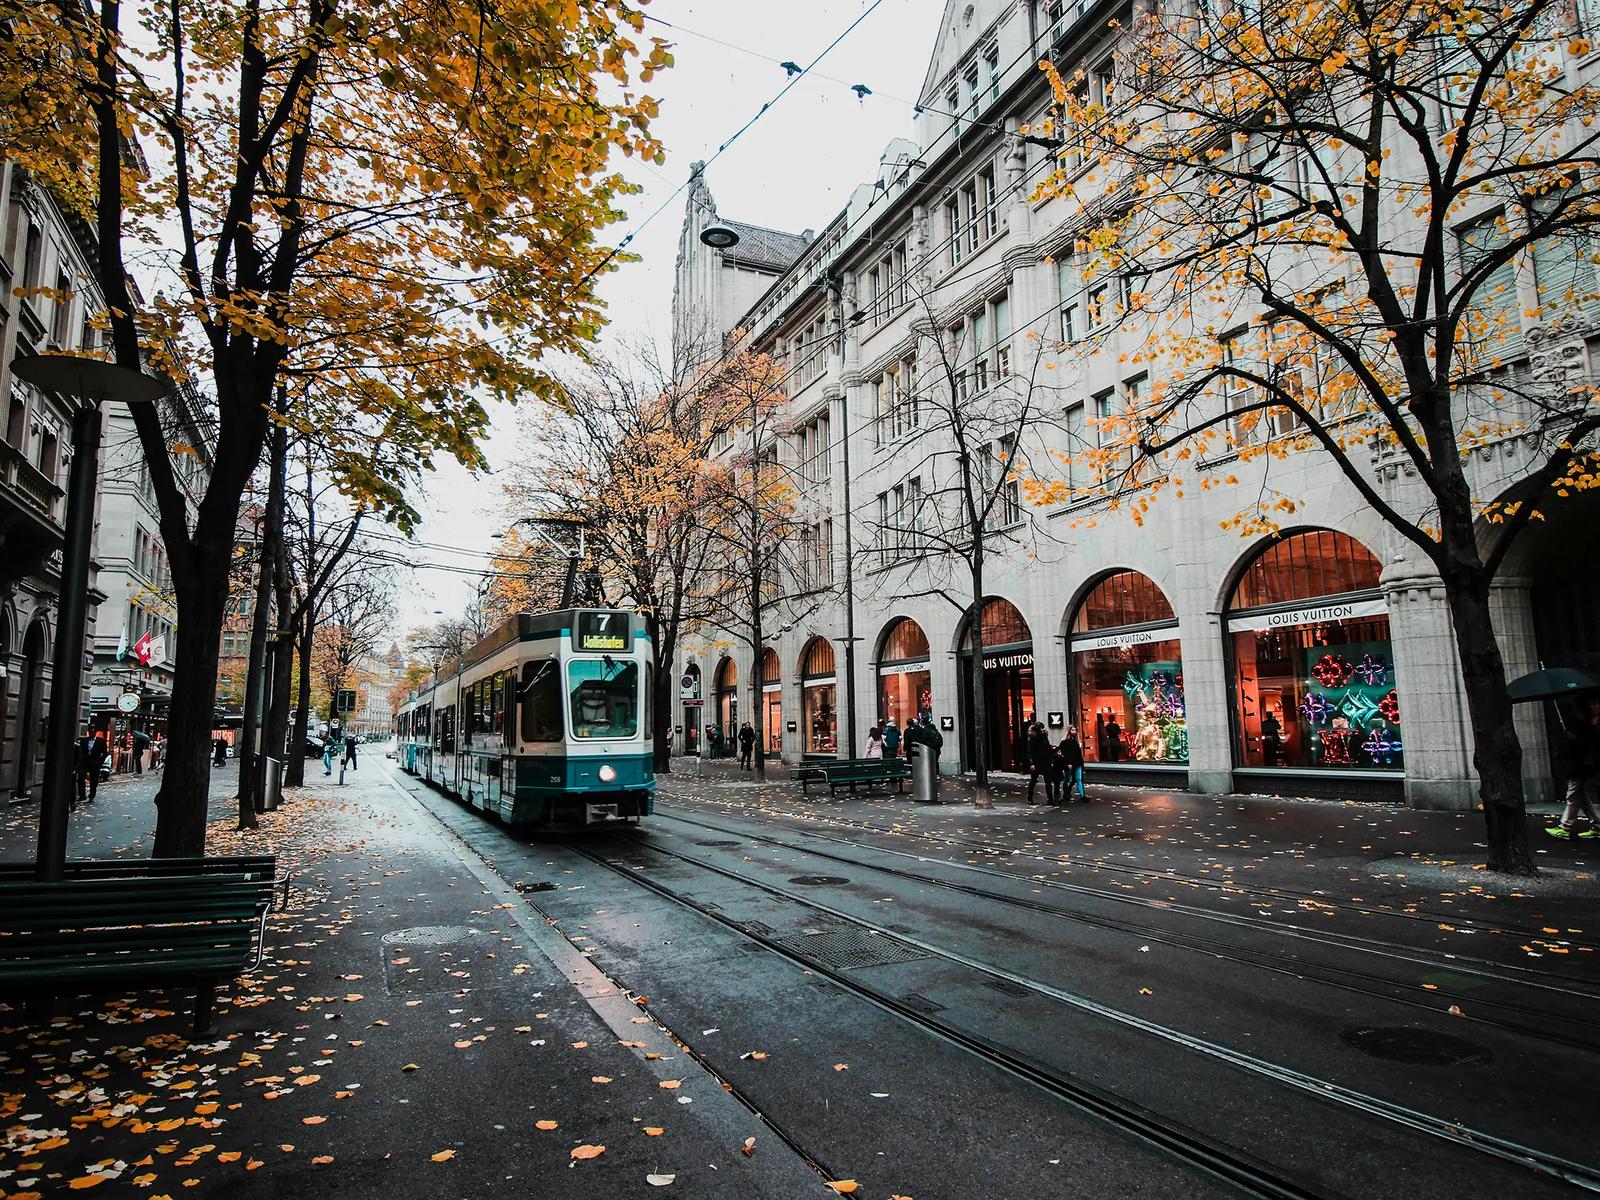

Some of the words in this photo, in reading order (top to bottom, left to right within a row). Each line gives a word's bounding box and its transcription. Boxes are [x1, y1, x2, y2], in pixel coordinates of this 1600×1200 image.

[597, 613, 611, 631] 7
[1268, 612, 1299, 626] LOUIS
[1302, 606, 1353, 621] VUITTON
[1097, 636, 1118, 647] LOUIS
[1120, 632, 1152, 644] VUITTON
[982, 658, 997, 670] UIS
[998, 653, 1035, 667] VUITTON
